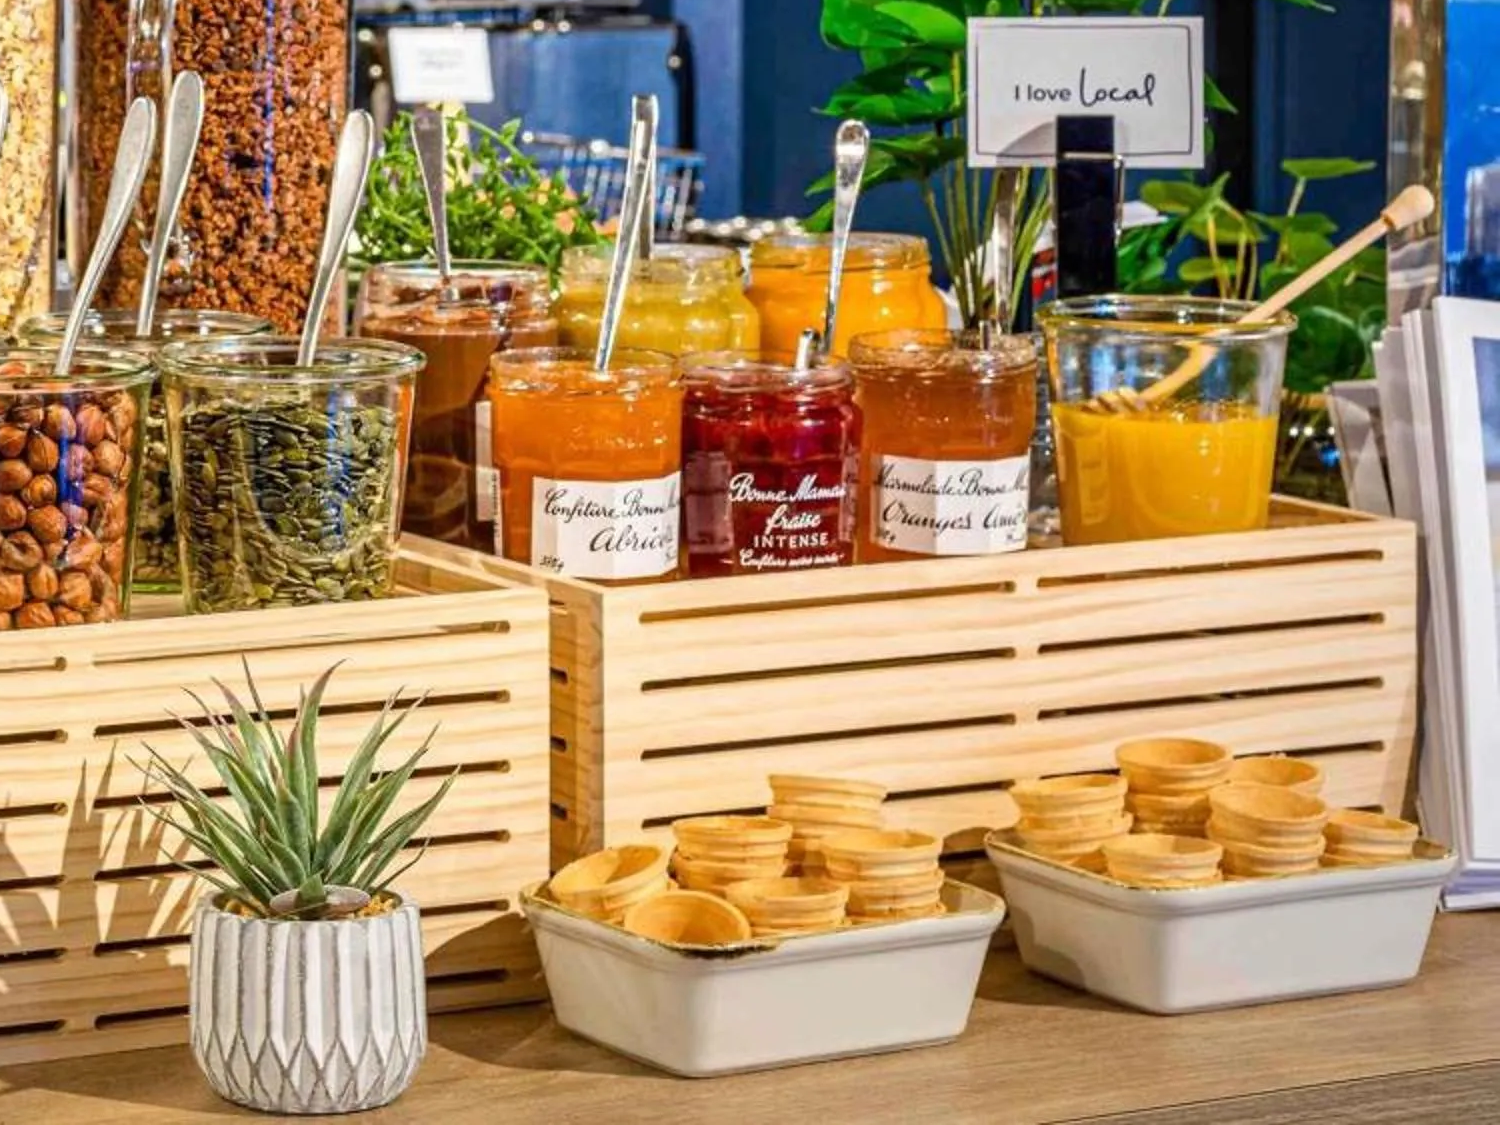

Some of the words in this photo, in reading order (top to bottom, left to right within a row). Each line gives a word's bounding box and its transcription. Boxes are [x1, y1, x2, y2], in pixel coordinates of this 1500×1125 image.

[1014, 84, 1021, 101] I
[1027, 84, 1071, 101] love
[1079, 66, 1156, 107] Local
[729, 472, 788, 502] Bonne
[882, 498, 972, 536] Oranges
[753, 532, 829, 549] INTENSE
